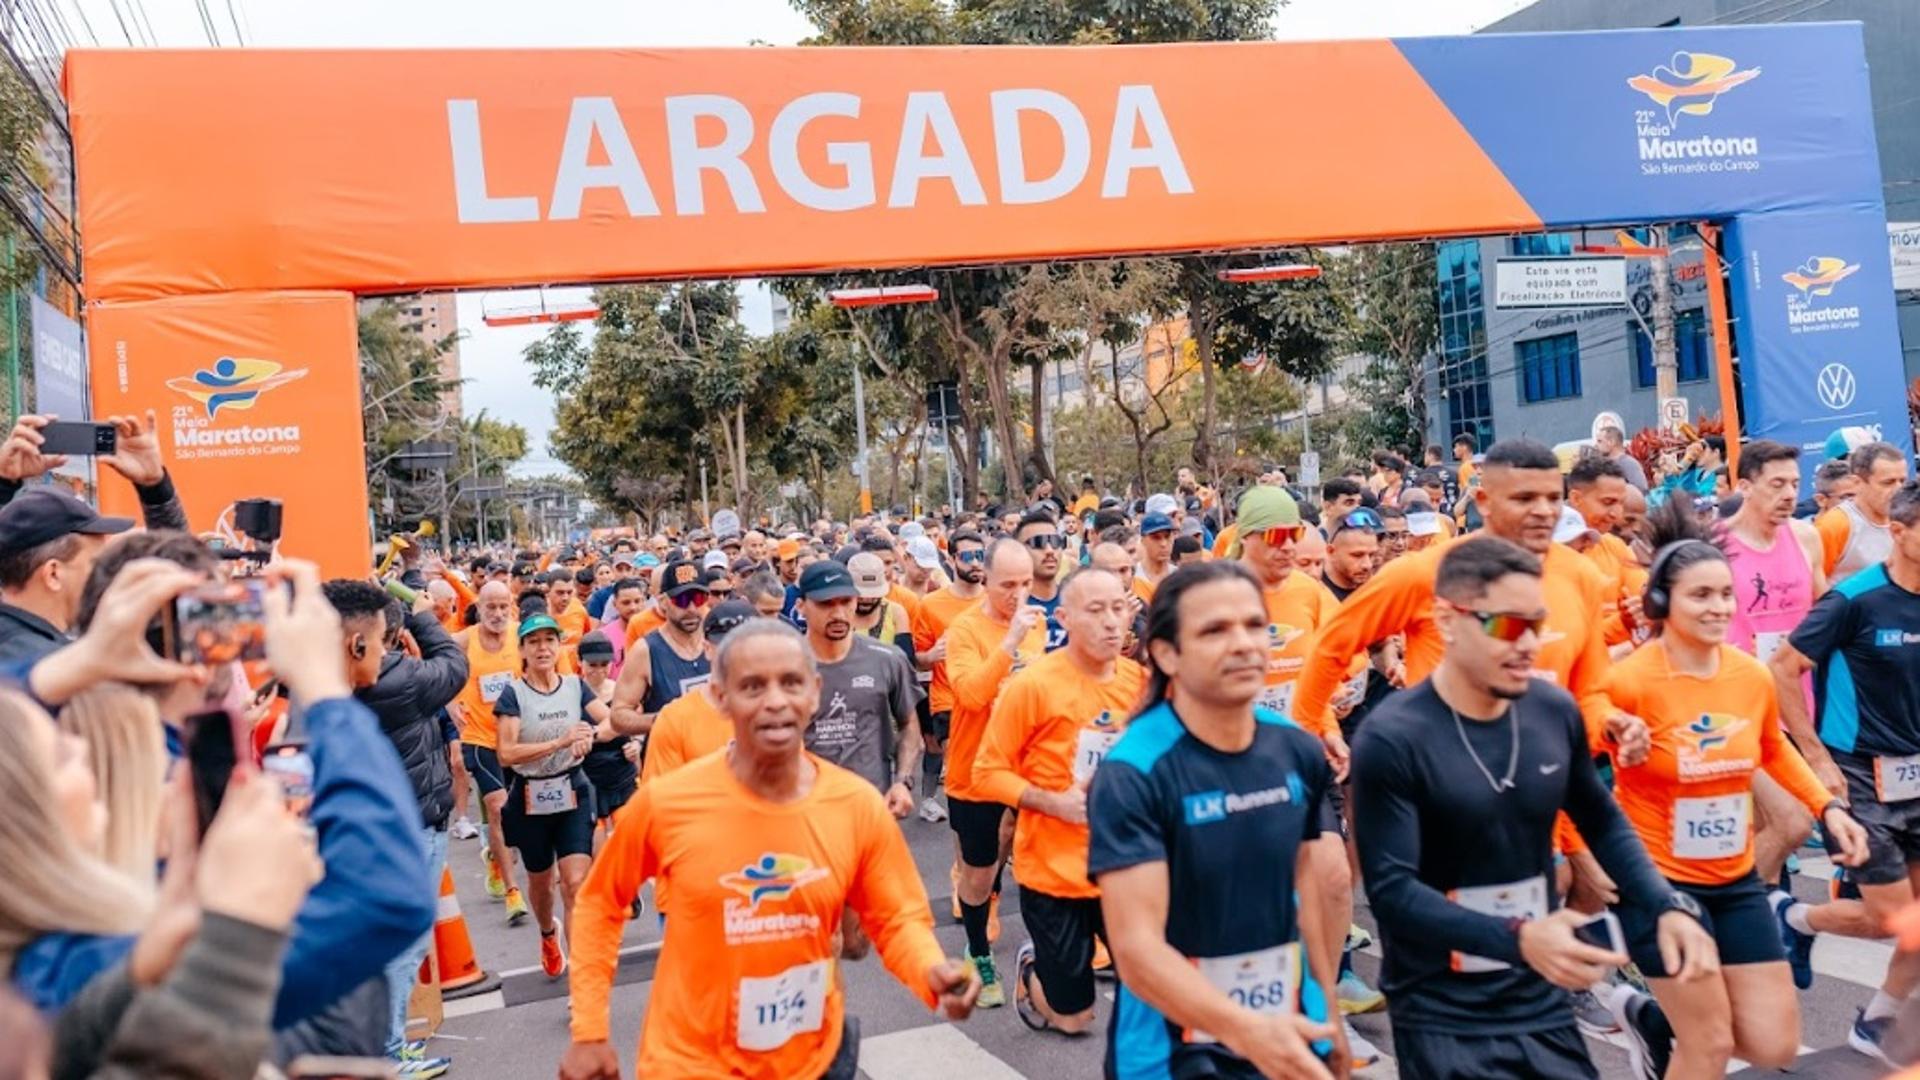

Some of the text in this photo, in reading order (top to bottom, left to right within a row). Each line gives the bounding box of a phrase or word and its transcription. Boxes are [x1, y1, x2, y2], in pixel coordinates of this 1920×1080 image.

[1637, 123, 1670, 136] Meia
[447, 84, 1194, 224] LARGADA
[1640, 136, 1757, 159] Maratona
[1641, 159, 1759, 175] São Bernardo do Campo
[1526, 278, 1598, 289] equipada com
[1789, 307, 1859, 324] Maratona
[174, 417, 208, 428] Meia
[174, 426, 300, 447] Maratona
[176, 447, 196, 460] São
[198, 446, 246, 458] Bernardo
[263, 444, 300, 455] Campo
[537, 789, 564, 801] 643
[1194, 786, 1290, 819] LK Runners
[1686, 817, 1736, 838] 1652
[725, 912, 820, 934] Maratona
[756, 990, 806, 1025] 1134
